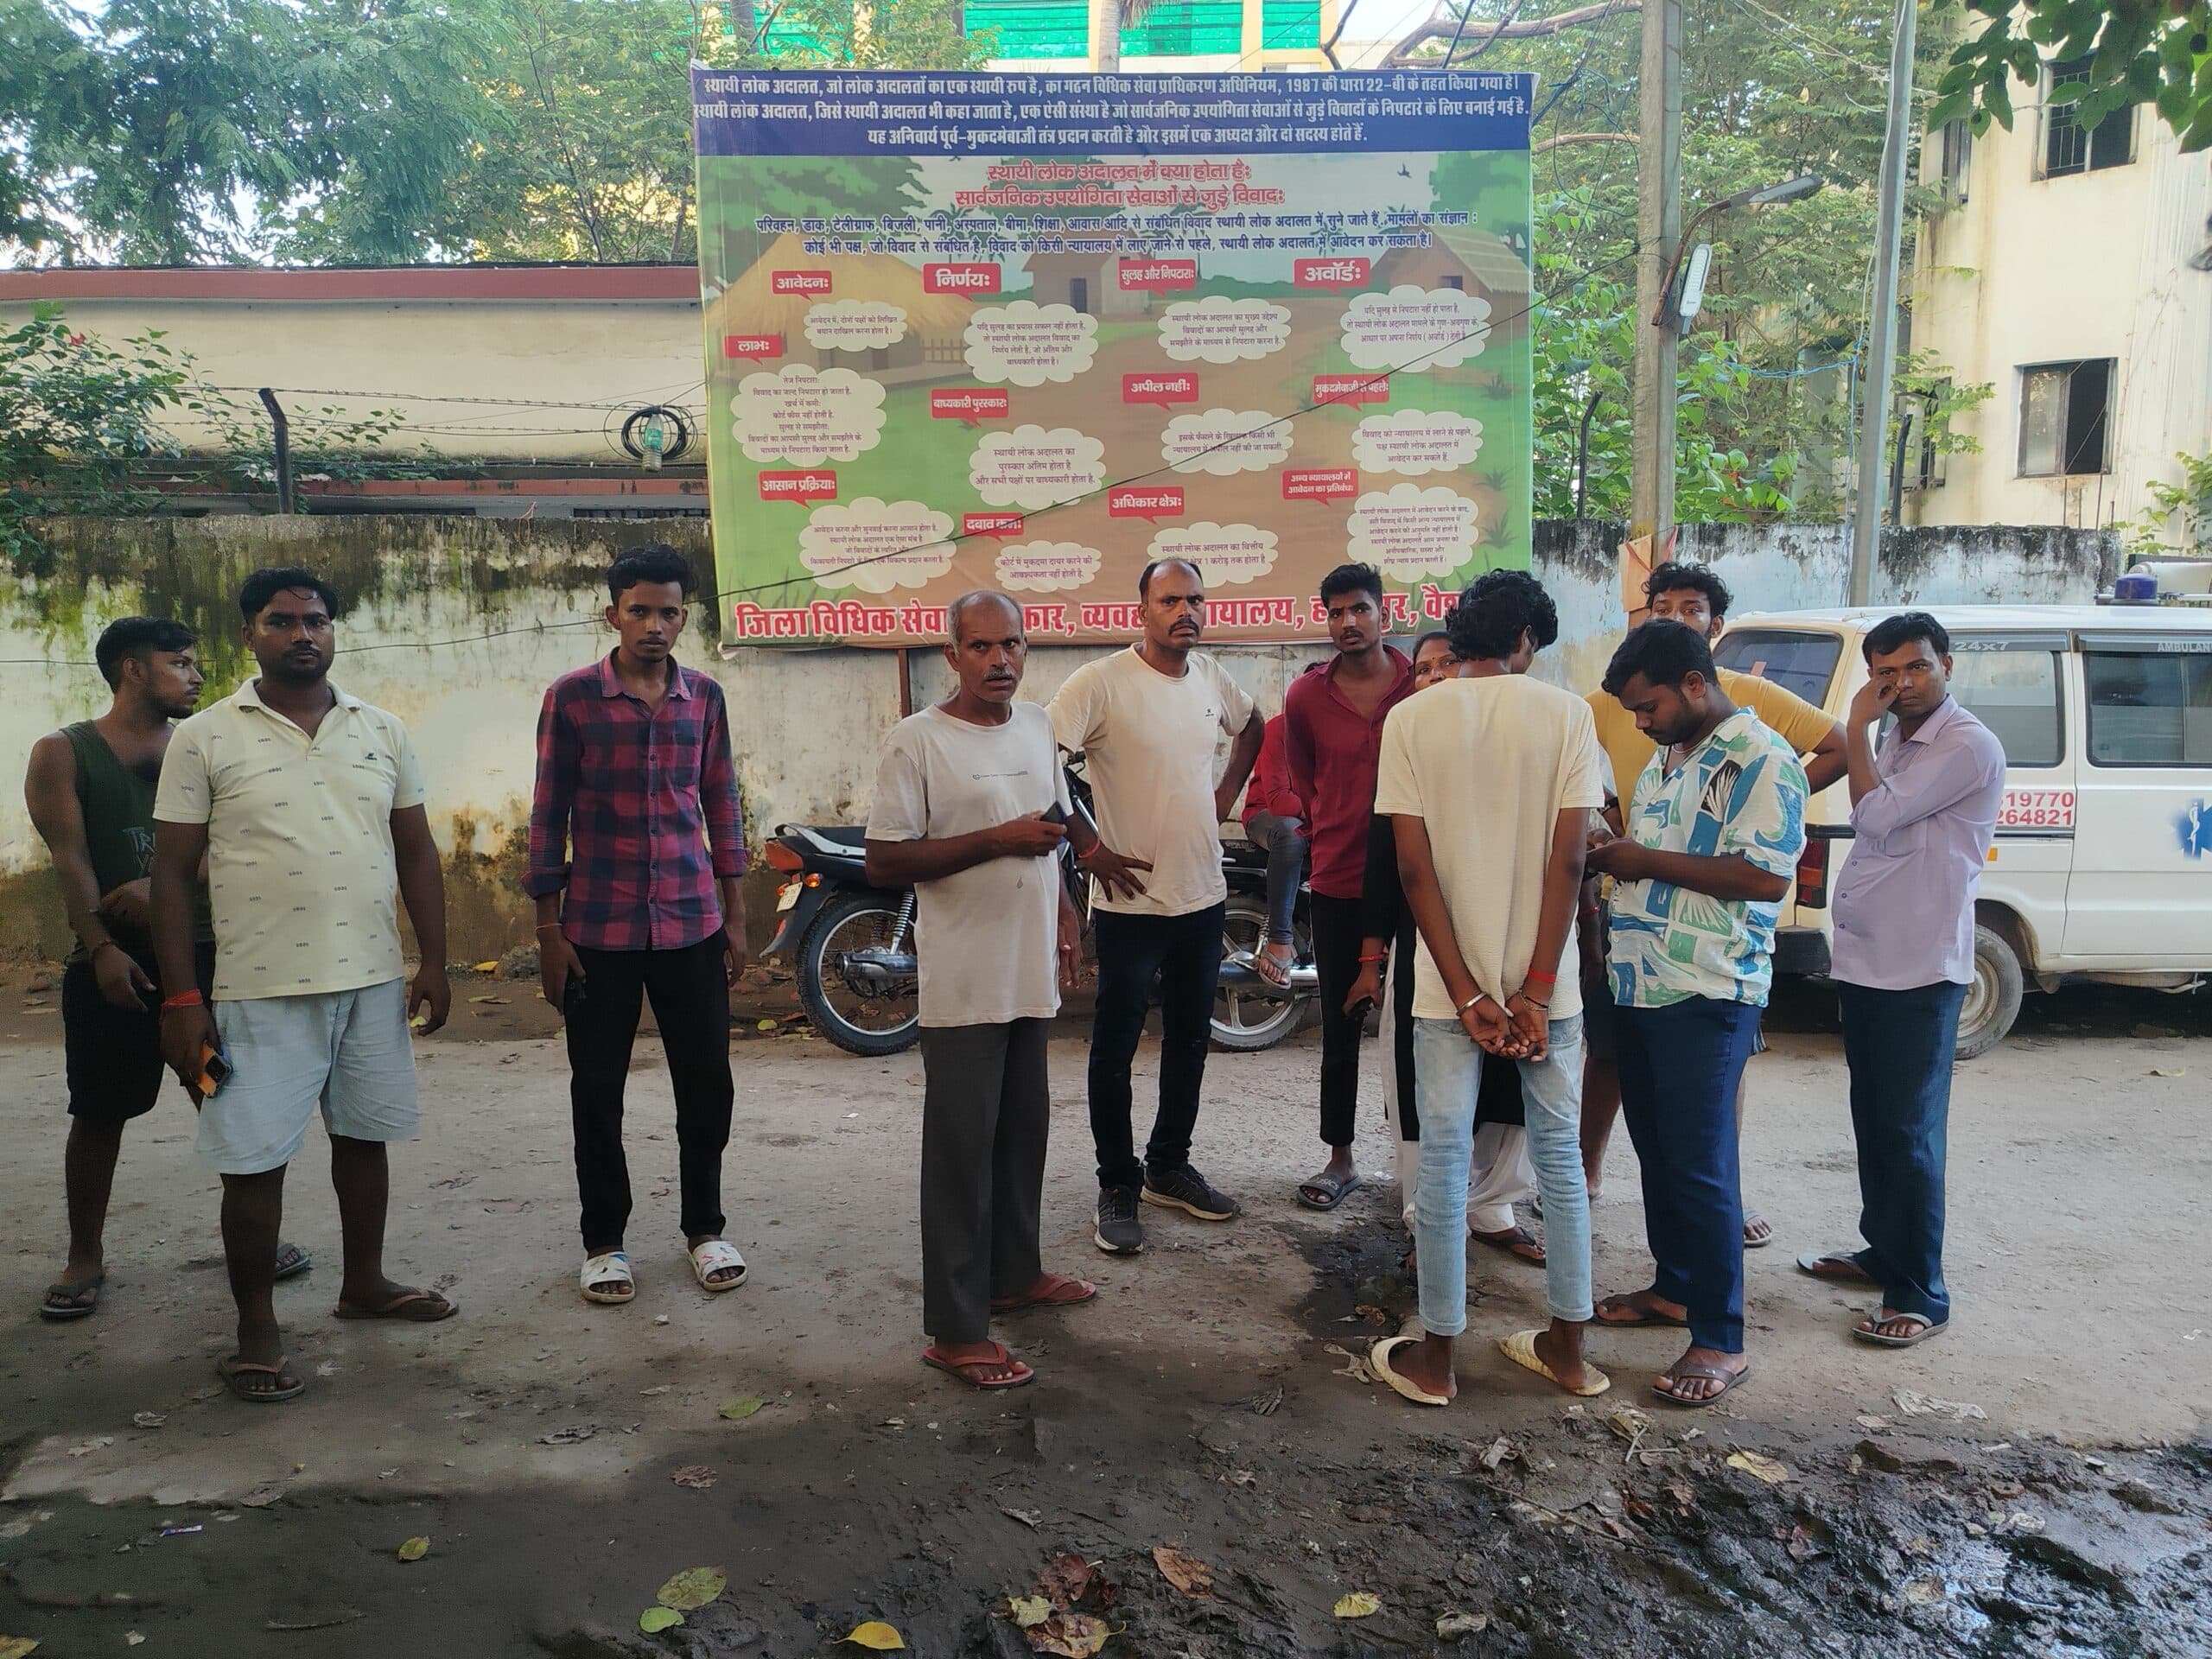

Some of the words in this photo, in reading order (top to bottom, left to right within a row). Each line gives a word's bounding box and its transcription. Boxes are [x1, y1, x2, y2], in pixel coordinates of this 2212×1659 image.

[704, 75, 739, 94] स्थायी
[741, 75, 770, 94] लोक
[772, 78, 823, 97] अदालत,
[826, 75, 842, 94] जो
[845, 75, 874, 94] लोक
[876, 75, 927, 94] अदालतों
[928, 79, 944, 94] का
[947, 79, 968, 94] एक
[970, 76, 1003, 94] स्थायी
[1027, 76, 1042, 97] है,
[1046, 79, 1061, 93] का
[1093, 76, 1131, 93] विधिक
[1134, 76, 1156, 93] सेवा
[1159, 76, 1217, 94] प्राधिकरण
[1219, 76, 1281, 96] अधिनियम,
[1287, 79, 1318, 92] 1987
[1321, 75, 1338, 92] की
[1340, 79, 1363, 92] धारा
[1408, 75, 1419, 92] के
[1421, 78, 1446, 92] तहत
[1448, 75, 1478, 91] किया
[1480, 78, 1503, 91] गया
[693, 100, 727, 119] स्थायी
[730, 100, 759, 119] लोक
[762, 104, 812, 123] अदालत,
[815, 100, 842, 119] जिसे
[844, 101, 879, 119] स्थायी
[881, 105, 926, 119] अदालत
[929, 101, 943, 119] भी
[945, 105, 969, 119] कहा
[973, 105, 1001, 119] जाता
[1001, 99, 1018, 123] है,
[1020, 105, 1040, 118] एक
[1043, 100, 1066, 118] ऐसी
[1069, 99, 1099, 118] संस्था
[1100, 99, 1110, 118] है
[1113, 99, 1128, 118] जो
[1130, 100, 1190, 118] सार्वजनिक
[1193, 99, 1249, 118] उपयोगिता
[1252, 99, 1291, 118] सेवाओं
[1294, 99, 1303, 117] से
[1306, 99, 1325, 121] जुड़े
[1328, 98, 1366, 117] विवादों
[1368, 99, 1379, 117] के
[1382, 98, 1422, 116] निपटारे
[1425, 98, 1435, 115] के
[1439, 98, 1461, 115] लिए
[1465, 97, 1494, 117] बनाई
[1497, 97, 1514, 116] गई
[868, 130, 886, 144] यह
[889, 126, 938, 144] अनिवार्य
[1039, 125, 1055, 144] तंत्र
[1058, 130, 1089, 145] प्रदान
[1091, 126, 1122, 143] करती
[1125, 124, 1135, 143] है
[1136, 124, 1159, 143] और
[1161, 124, 1190, 145] इसमें
[1192, 129, 1211, 143] एक
[1215, 129, 1253, 143] अध्यक्ष
[1255, 124, 1278, 143] और
[1281, 124, 1293, 142] दो
[1295, 128, 1328, 143] सदस्य
[1331, 124, 1351, 142] होते
[988, 159, 1034, 181] स्थायी
[1037, 161, 1075, 181] लोक
[1078, 164, 1139, 181] अदालत
[1142, 159, 1158, 181] में
[1160, 164, 1190, 181] क्या
[1193, 159, 1228, 180] होता
[955, 185, 1041, 208] सार्वजनिक
[1044, 184, 1122, 207] उपयोगिता
[1126, 183, 1178, 207] सेवाओं
[1181, 184, 1196, 205] से
[756, 214, 799, 234] परिवहन,
[802, 218, 830, 234] डाक,
[832, 214, 880, 233] टेलीग्राफ,
[882, 214, 920, 233] बिजली,
[924, 214, 951, 232] पानी,
[954, 218, 1001, 232] अस्पताल,
[1005, 214, 1032, 232] बीमा,
[1035, 214, 1065, 232] शिक्षा,
[1068, 218, 1101, 232] आवास
[1104, 214, 1128, 232] आदि
[1132, 214, 1141, 231] से
[1145, 213, 1180, 231] संबंधित
[1184, 214, 1211, 230] विवाद
[1215, 212, 1245, 229] स्थायी
[1249, 212, 1271, 228] लोक
[1274, 214, 1312, 228] अदालत
[1314, 211, 1324, 227] में
[1327, 211, 1344, 231] सुने
[1348, 211, 1368, 226] जाते
[1387, 209, 1419, 226] मामलों
[1421, 213, 1435, 225] का
[1438, 208, 1469, 225] संज्ञान
[1121, 269, 1143, 285] सुलह
[1145, 264, 1160, 280] और
[1130, 379, 1164, 392] अपील
[994, 447, 1015, 457] स्थायी
[1018, 447, 1034, 456] लोक
[999, 462, 1024, 474] पुरस्कार
[1049, 460, 1065, 470] होता
[762, 480, 797, 492] आसान
[1112, 494, 1158, 509] अधिकार
[736, 601, 810, 639] जिला
[810, 598, 897, 637] विधिक
[900, 598, 950, 636] सेवा
[1955, 641, 2008, 651] 24x7
[2000, 791, 2074, 807] 19770
